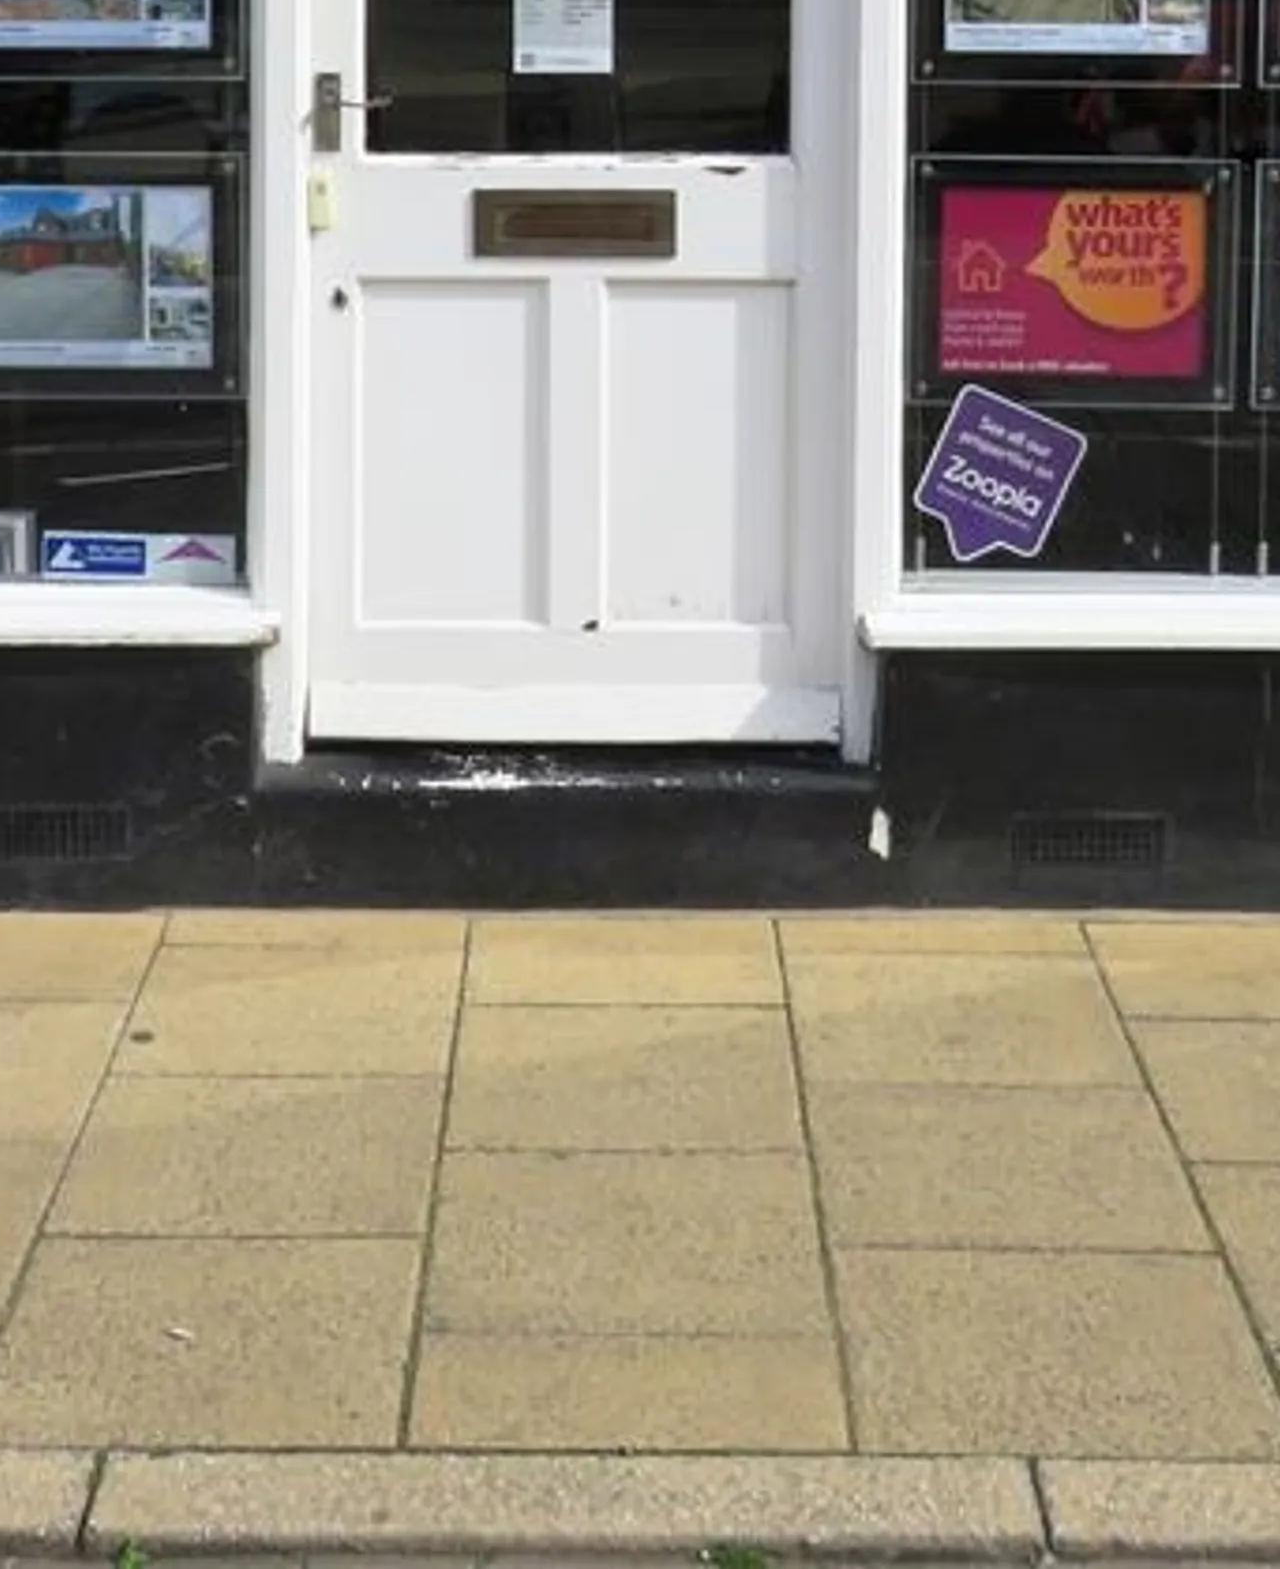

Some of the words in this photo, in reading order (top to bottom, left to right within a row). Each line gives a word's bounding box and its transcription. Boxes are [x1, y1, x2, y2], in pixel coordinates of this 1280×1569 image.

[1066, 196, 1182, 228] what's
[1065, 229, 1182, 269] yours
[942, 454, 1044, 517] Zoopla
